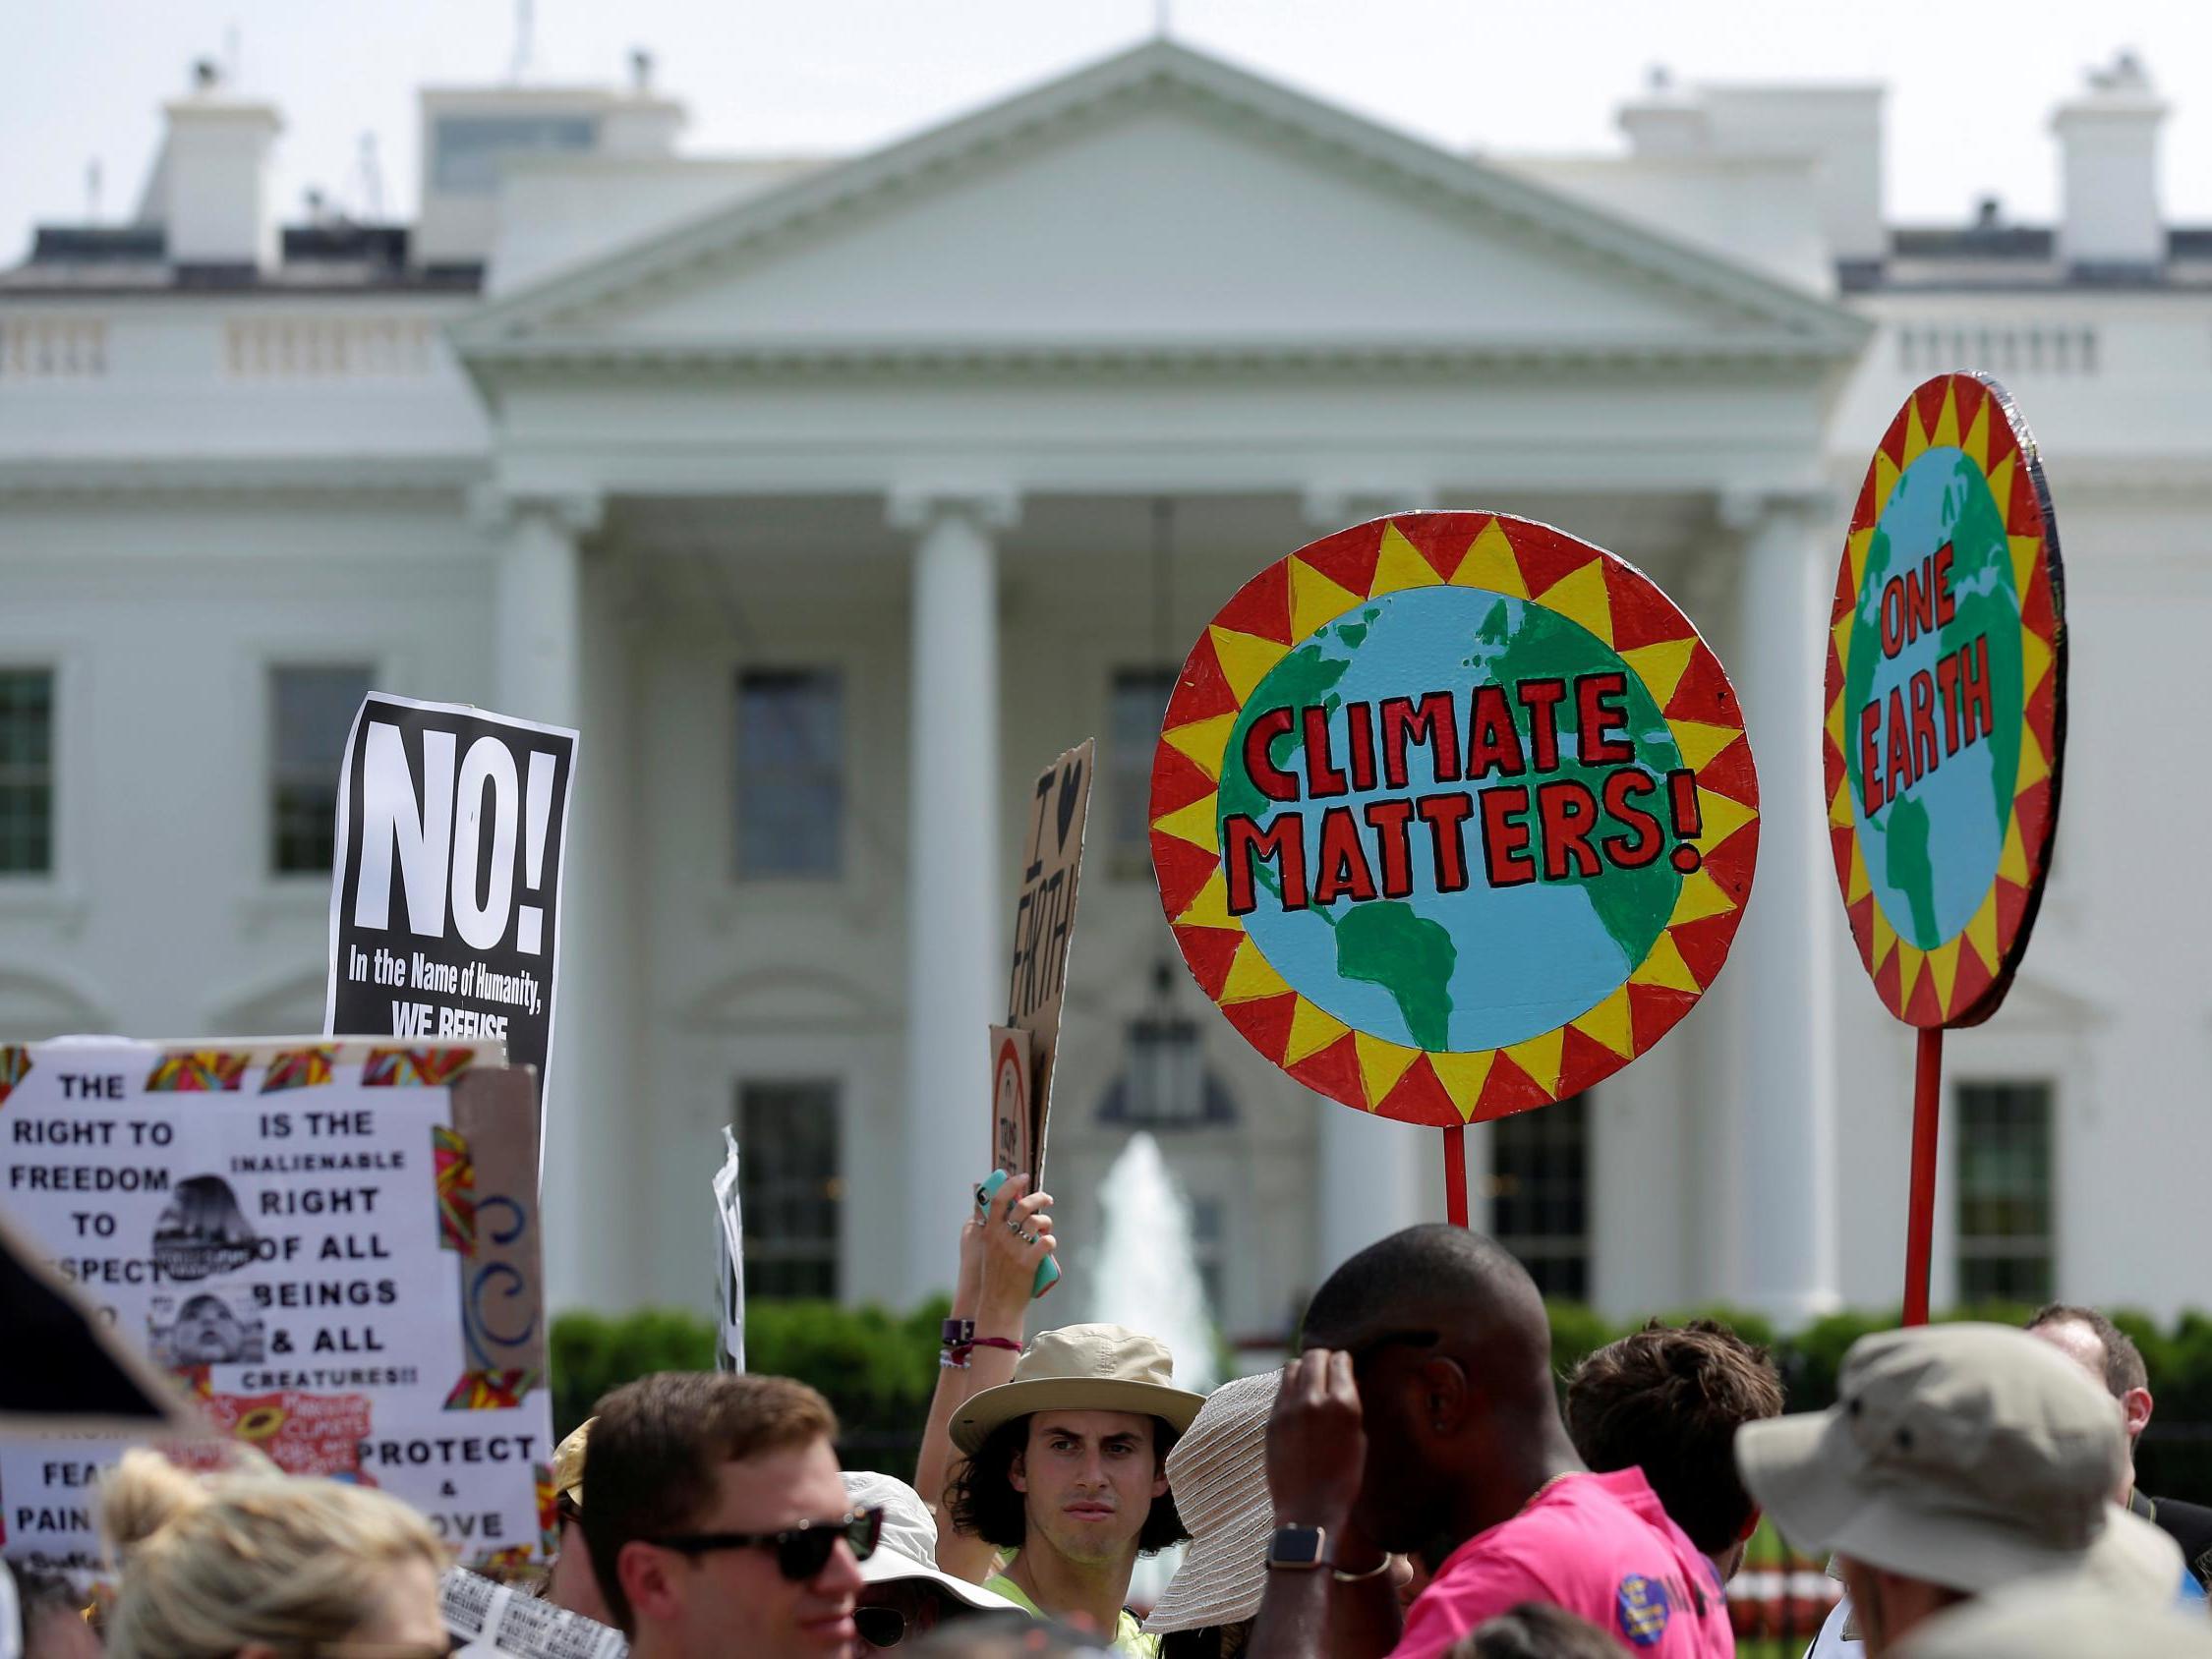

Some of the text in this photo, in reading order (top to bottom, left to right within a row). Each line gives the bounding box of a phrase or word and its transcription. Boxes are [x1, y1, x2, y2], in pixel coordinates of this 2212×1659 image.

[1880, 540, 1955, 659] ONE
[1242, 671, 1636, 802] CLIMATE
[1861, 632, 1993, 819] EARTH
[354, 720, 556, 955] NO!
[1025, 770, 1056, 884] I
[1222, 768, 1703, 916] MATTERS!
[348, 944, 541, 1015] In the Name of Humanity,
[392, 1000, 433, 1039] WE
[57, 1073, 125, 1101] THE
[13, 1118, 173, 1146] RIGHT TO
[259, 1110, 374, 1138] IS THE
[229, 1149, 405, 1173] INALIENABLE
[10, 1165, 168, 1190] FREEDOM
[260, 1186, 379, 1216] RIGHT
[71, 1212, 116, 1238] TO
[257, 1232, 390, 1262] OF ALL
[253, 1278, 396, 1309] BEINGS
[270, 1325, 384, 1354] & ALL
[357, 1435, 537, 1466] PROTECT
